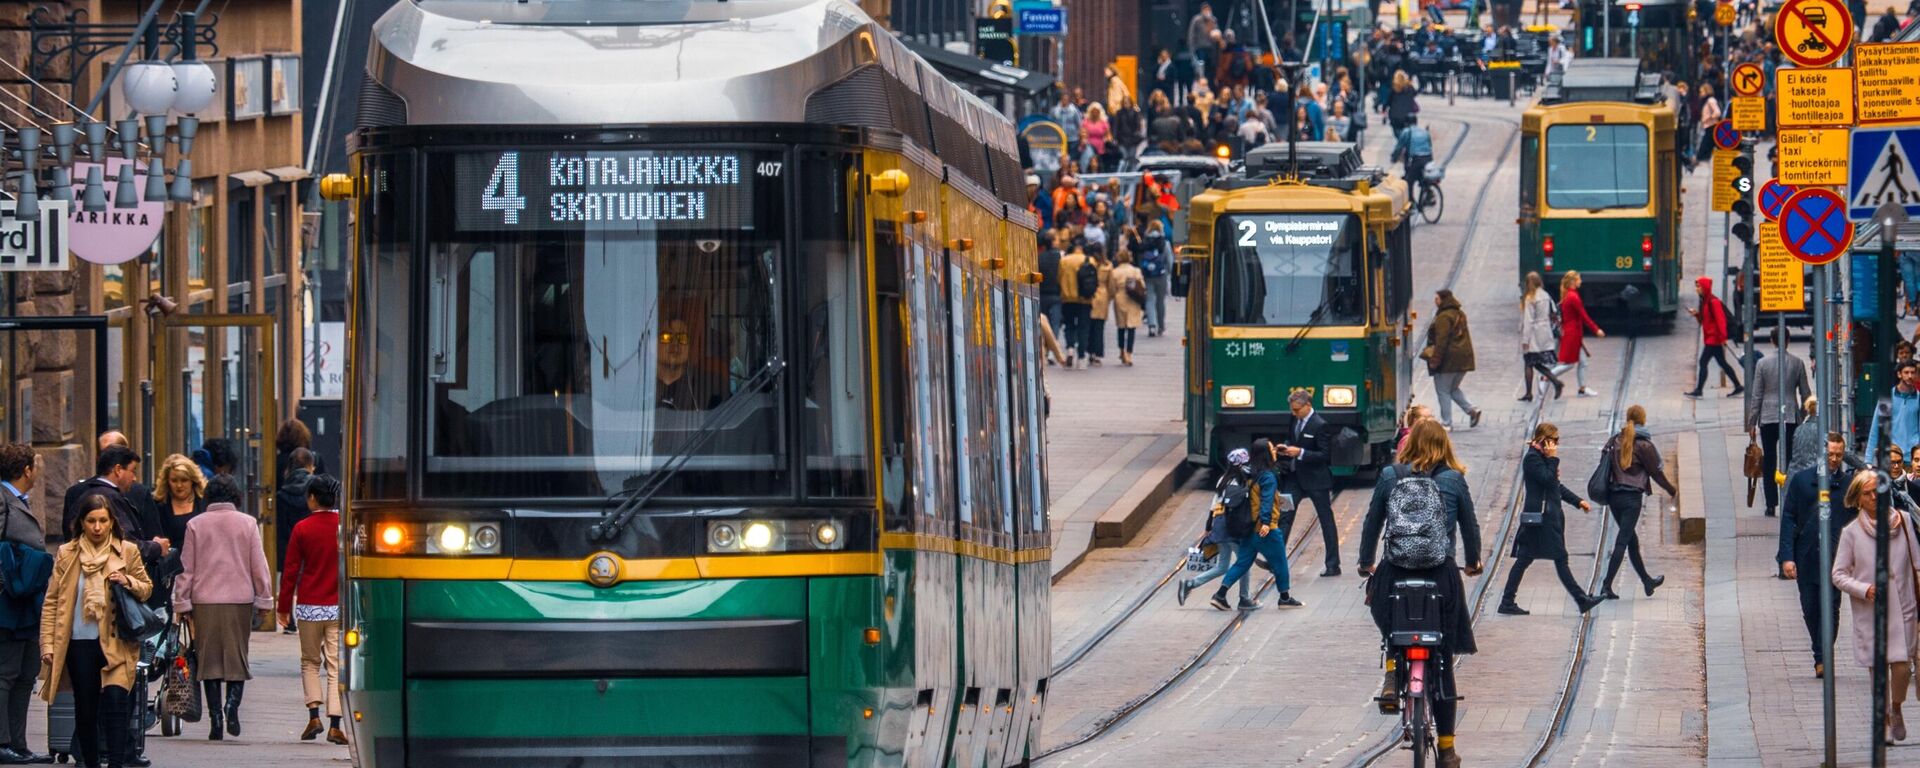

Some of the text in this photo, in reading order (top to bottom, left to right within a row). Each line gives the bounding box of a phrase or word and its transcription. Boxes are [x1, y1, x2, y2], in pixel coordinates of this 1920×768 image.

[1787, 74, 1827, 84] Ei koske
[1859, 68, 1888, 77] sallittu
[1862, 88, 1903, 98] purkaville
[1863, 99, 1912, 109] ajoneuvoille
[1780, 133, 1821, 145] Gäller ej
[756, 161, 783, 177] 407
[1781, 157, 1848, 168] -servicekörnin
[549, 155, 740, 186] KATAJANOKKA
[481, 151, 527, 225] 4
[1738, 177, 1752, 193] S
[549, 191, 706, 221] SKATUDDEN
[68, 211, 149, 226] ARIKKA
[1238, 219, 1257, 246] 2
[1269, 234, 1332, 246] via Kauppatori
[1616, 256, 1633, 269] 89
